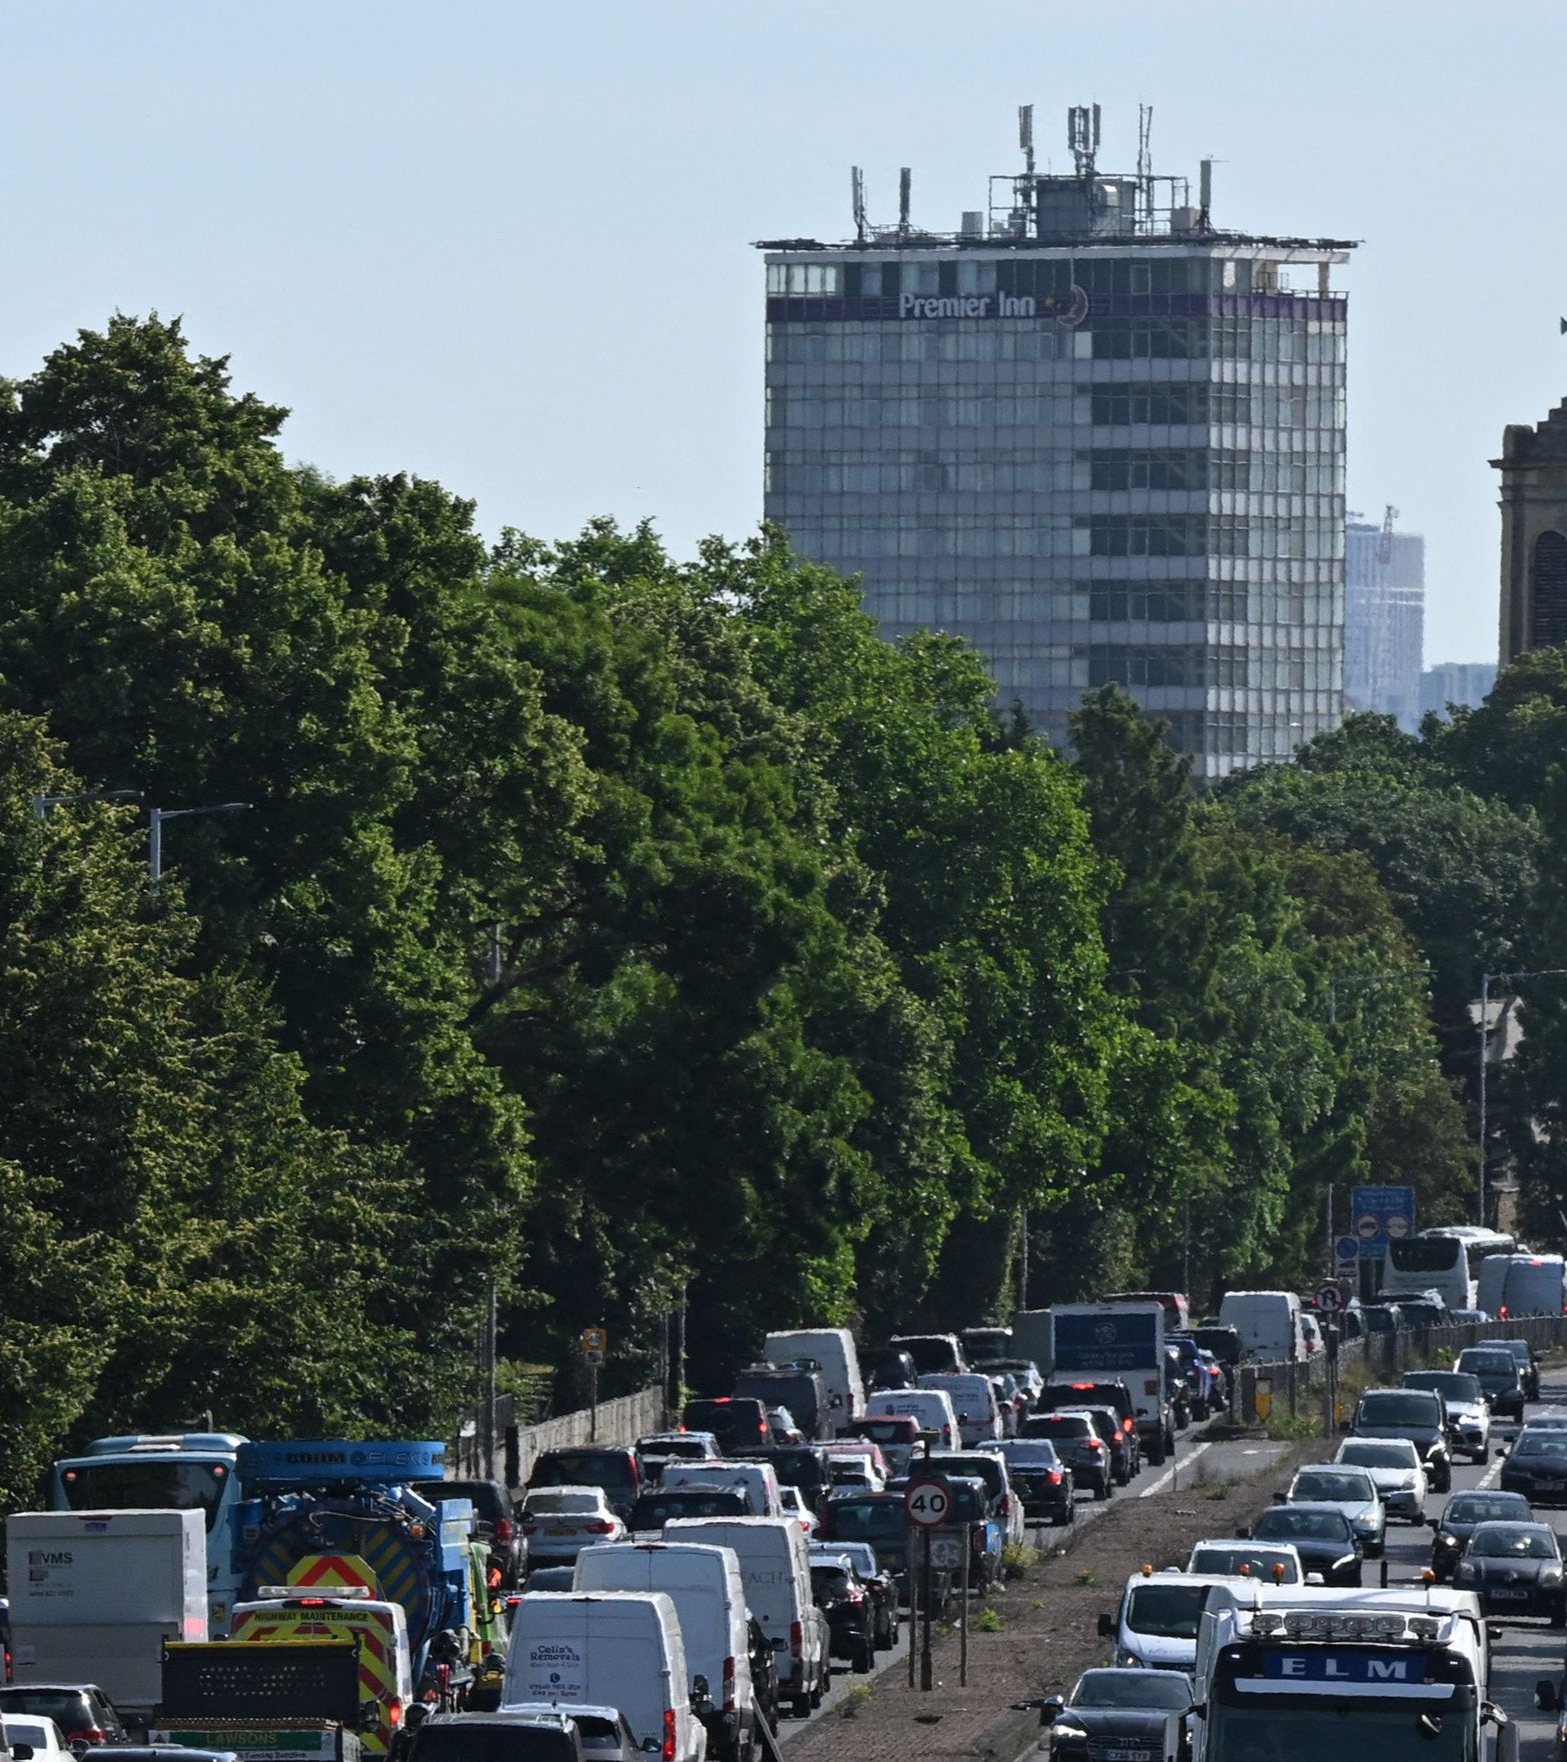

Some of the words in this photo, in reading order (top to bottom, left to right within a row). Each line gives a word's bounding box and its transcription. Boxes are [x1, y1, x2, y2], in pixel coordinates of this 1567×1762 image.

[899, 293, 990, 318] Premier
[999, 291, 1035, 316] Inn
[911, 1494, 946, 1514] 40
[41, 1552, 73, 1564] VMS
[254, 1612, 296, 1621] HIGHWAY
[300, 1612, 369, 1622] MAINTENANCE
[538, 1645, 573, 1654] Colin's
[530, 1652, 581, 1661] Removals
[1281, 1658, 1407, 1679] ELM
[206, 1733, 278, 1744] LAWSONS
